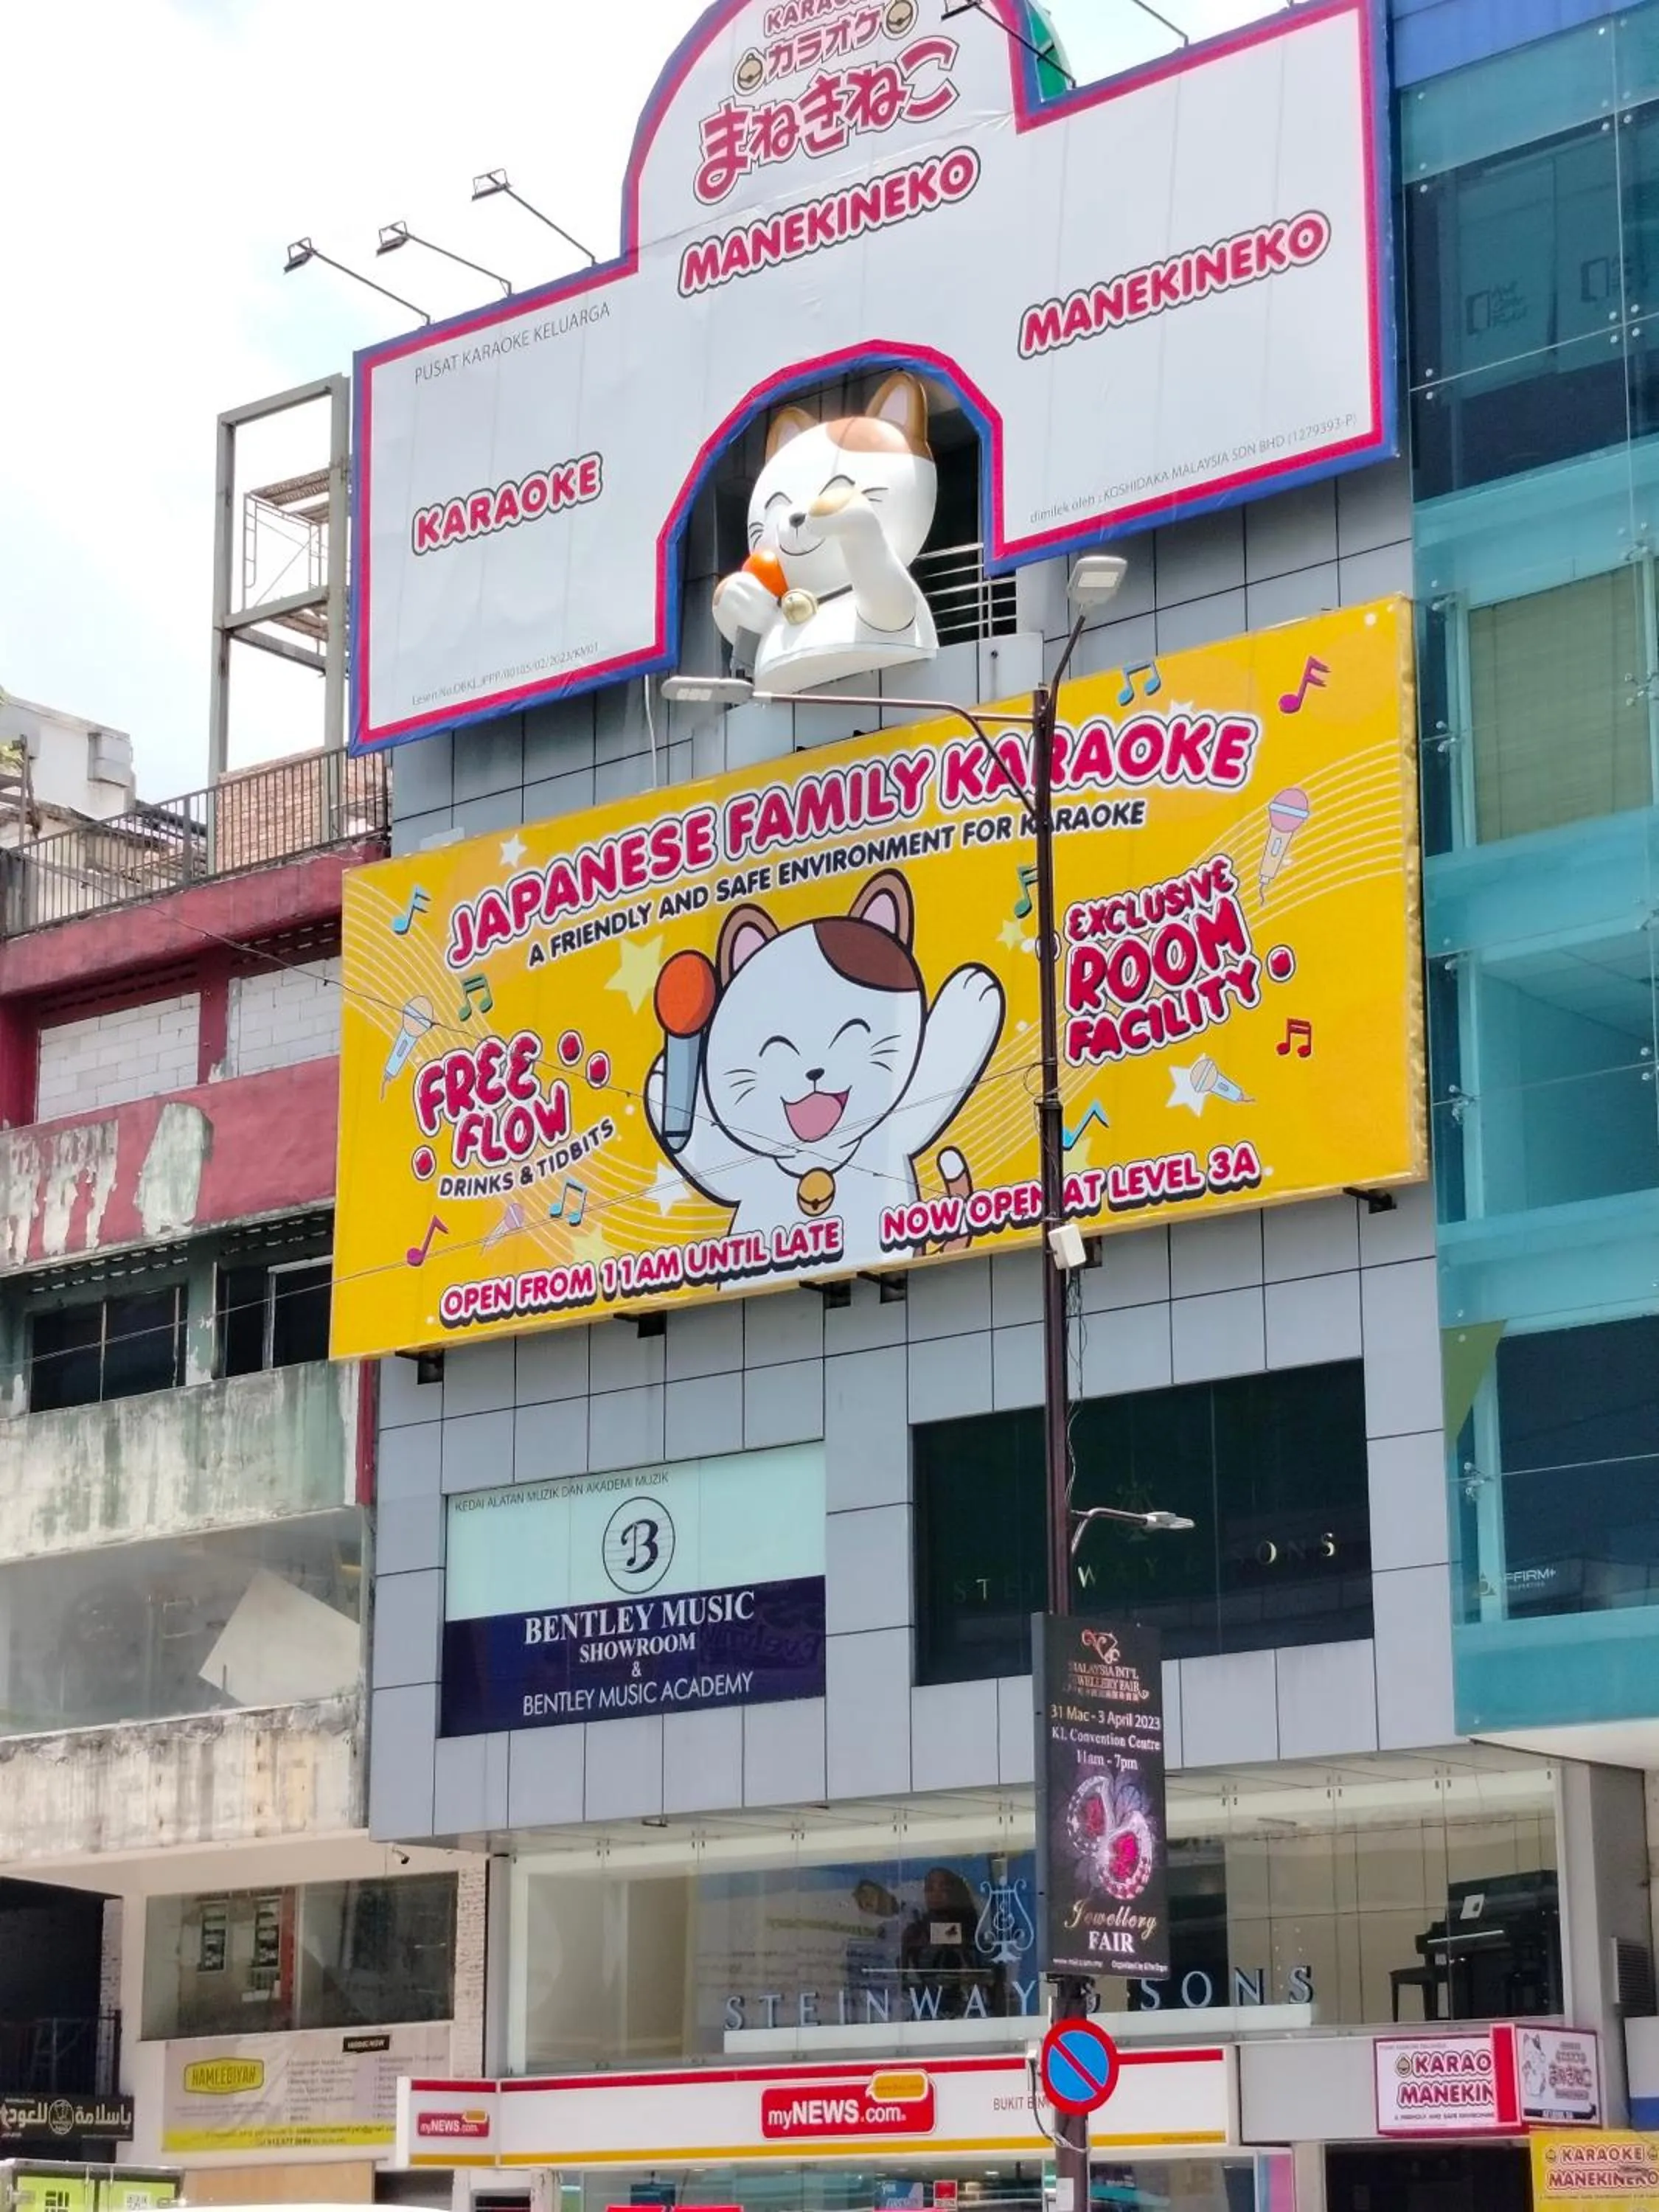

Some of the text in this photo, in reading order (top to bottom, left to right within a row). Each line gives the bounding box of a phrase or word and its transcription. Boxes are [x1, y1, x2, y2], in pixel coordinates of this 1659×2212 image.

[768, 9, 882, 77] カラオケ
[695, 39, 957, 204] まねきねこ
[681, 152, 975, 293] MANEKINEKO
[1021, 217, 1325, 353] MANEKINEKO
[415, 302, 611, 383] PUSAT KARAOKE KELUARGA
[414, 458, 599, 550] KARAOKE
[1071, 493, 1095, 511] oleh
[1104, 471, 1169, 502] KOSHIDAKA
[1172, 452, 1229, 480] MALAYSIA
[1232, 442, 1256, 462] SDN
[1259, 435, 1285, 453] BHD
[451, 720, 1254, 964] JAPANESE FAMILY KARAOKE
[528, 800, 1146, 967] A FRIENDLY AND SAFE ENVIRONMENT FOR KRAOKE
[1068, 858, 1235, 942] EXCLUSIVE
[1068, 895, 1247, 1011] ROOM
[1068, 959, 1257, 1060] FACILITY
[417, 1034, 538, 1131] FREE
[439, 1119, 614, 1197] DRINKS & TIDBITS
[455, 1083, 567, 1164] FLOW
[883, 1145, 1258, 1241] NOW OPEN AT LEVEL 3A
[442, 1220, 841, 1318] OPEN FROM 11AM UNTIL LATE
[455, 1471, 669, 1512] KEDAI ALATAN MUZIK DAN AKADEMI MUZIK
[524, 1590, 755, 1646] BENTLEY MUSIC
[579, 1632, 696, 1663] SHOWROOM
[523, 1671, 754, 1717] BENTLEY MUSIC ACADEMY
[630, 1661, 641, 1677] &
[1050, 1704, 1063, 1719] 31
[1066, 1705, 1090, 1722] Mac
[1098, 1709, 1105, 1724] 3
[1107, 1711, 1133, 1729] April
[1135, 1715, 1161, 1731] 2023
[1070, 1728, 1126, 1747] Convention
[1127, 1734, 1161, 1750] Centre
[1077, 1749, 1105, 1766] 11am
[1114, 1754, 1138, 1772] 7pm
[1064, 1898, 1158, 1941] Jewellery
[1088, 1930, 1135, 1953] FAIR
[724, 1979, 1037, 2031] STEINWAY
[1140, 1965, 1313, 2011] SONS
[768, 2099, 902, 2130] myNEWS.com
[993, 2096, 1024, 2111] BUKIT
[1562, 2146, 1643, 2162] KARAOKE
